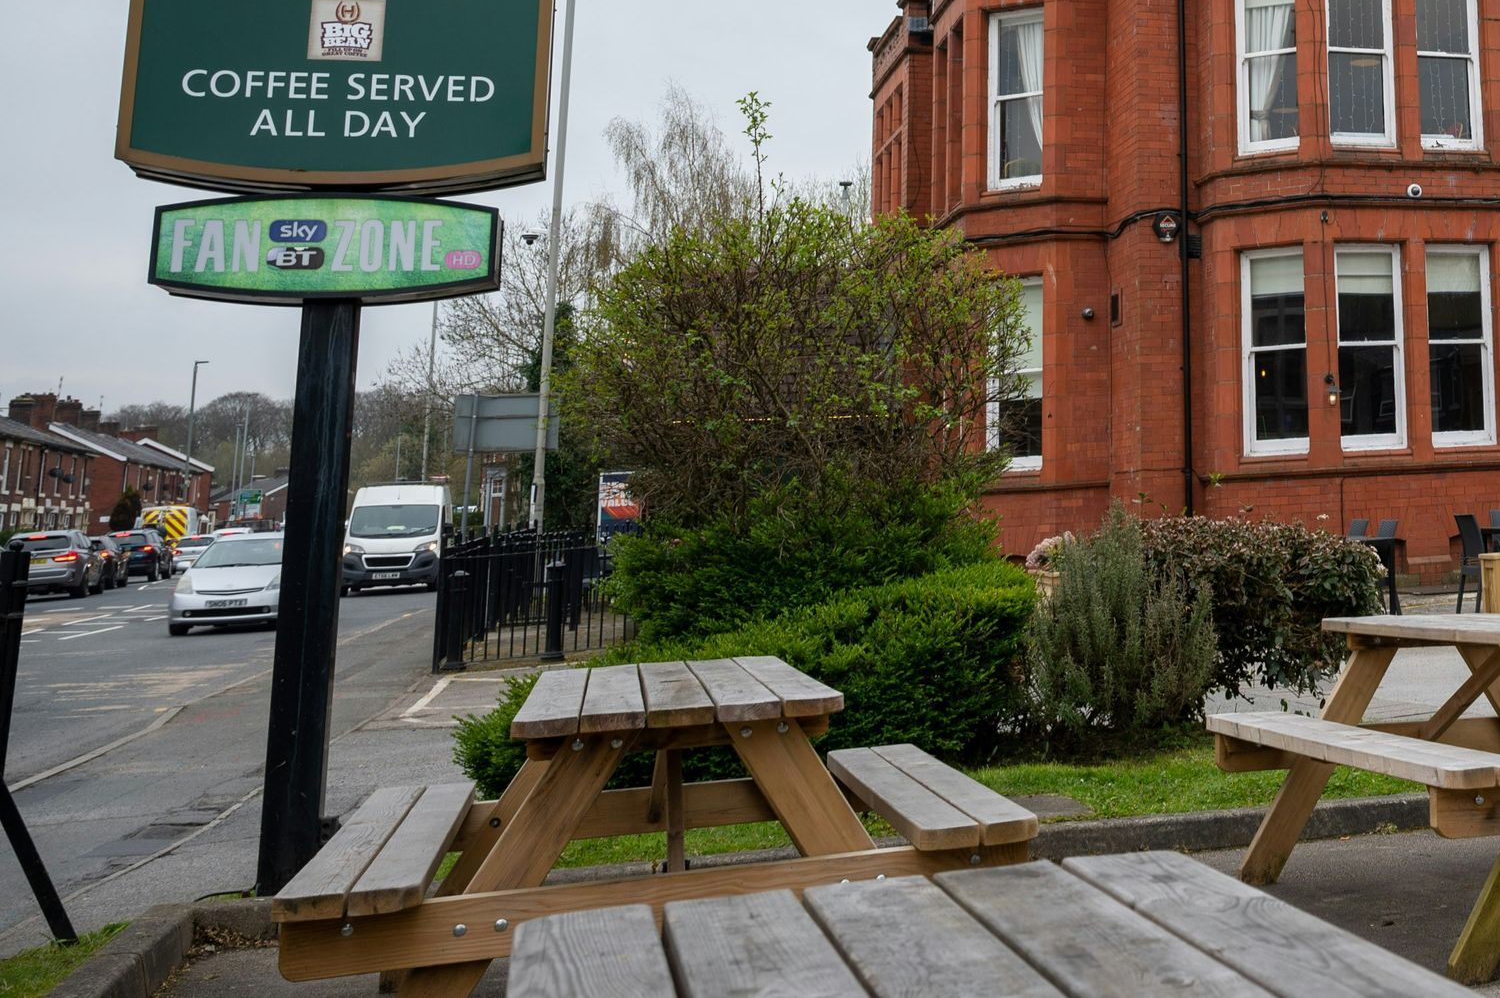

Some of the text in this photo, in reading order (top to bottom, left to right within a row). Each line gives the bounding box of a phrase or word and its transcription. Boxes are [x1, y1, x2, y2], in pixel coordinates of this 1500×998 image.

[322, 22, 370, 39] BIG
[322, 37, 370, 49] BEAN
[181, 68, 496, 103] COFFEE SERVED
[249, 108, 427, 139] ALL DAY
[279, 221, 319, 242] sky
[170, 219, 443, 273] FAN ZONE
[276, 250, 317, 266] BT
[451, 253, 477, 266] HD
